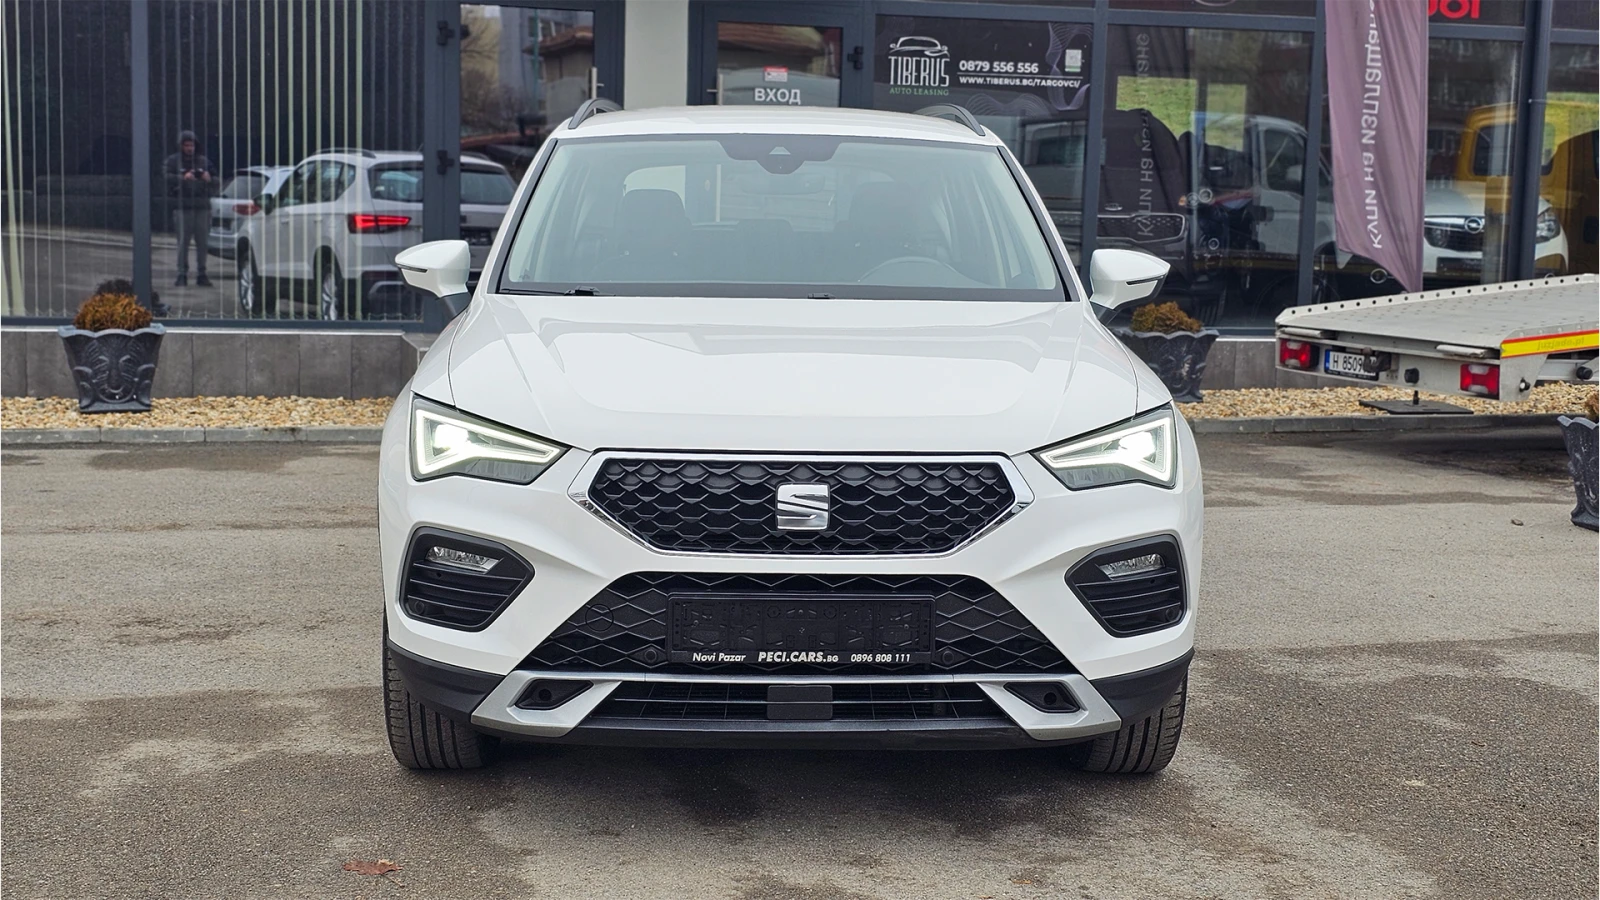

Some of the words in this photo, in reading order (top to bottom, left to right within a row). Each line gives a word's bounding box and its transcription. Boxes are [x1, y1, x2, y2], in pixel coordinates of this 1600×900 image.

[888, 56, 950, 87] TIBERUS
[959, 60, 990, 71] 0879
[992, 61, 1015, 73] 556
[1016, 62, 1039, 74] 556
[959, 76, 1081, 88] WWW.TIBERUS.BG/TARGOVCI/
[754, 87, 801, 105] ВХОД
[889, 87, 912, 95] AUTO
[913, 88, 949, 96] LEASING
[692, 652, 716, 662] Novi
[718, 652, 747, 662] Pazar
[757, 651, 839, 662] PECI.CARS.BG
[850, 653, 873, 662] 0896
[875, 653, 892, 662] 808
[895, 653, 911, 662] 111
